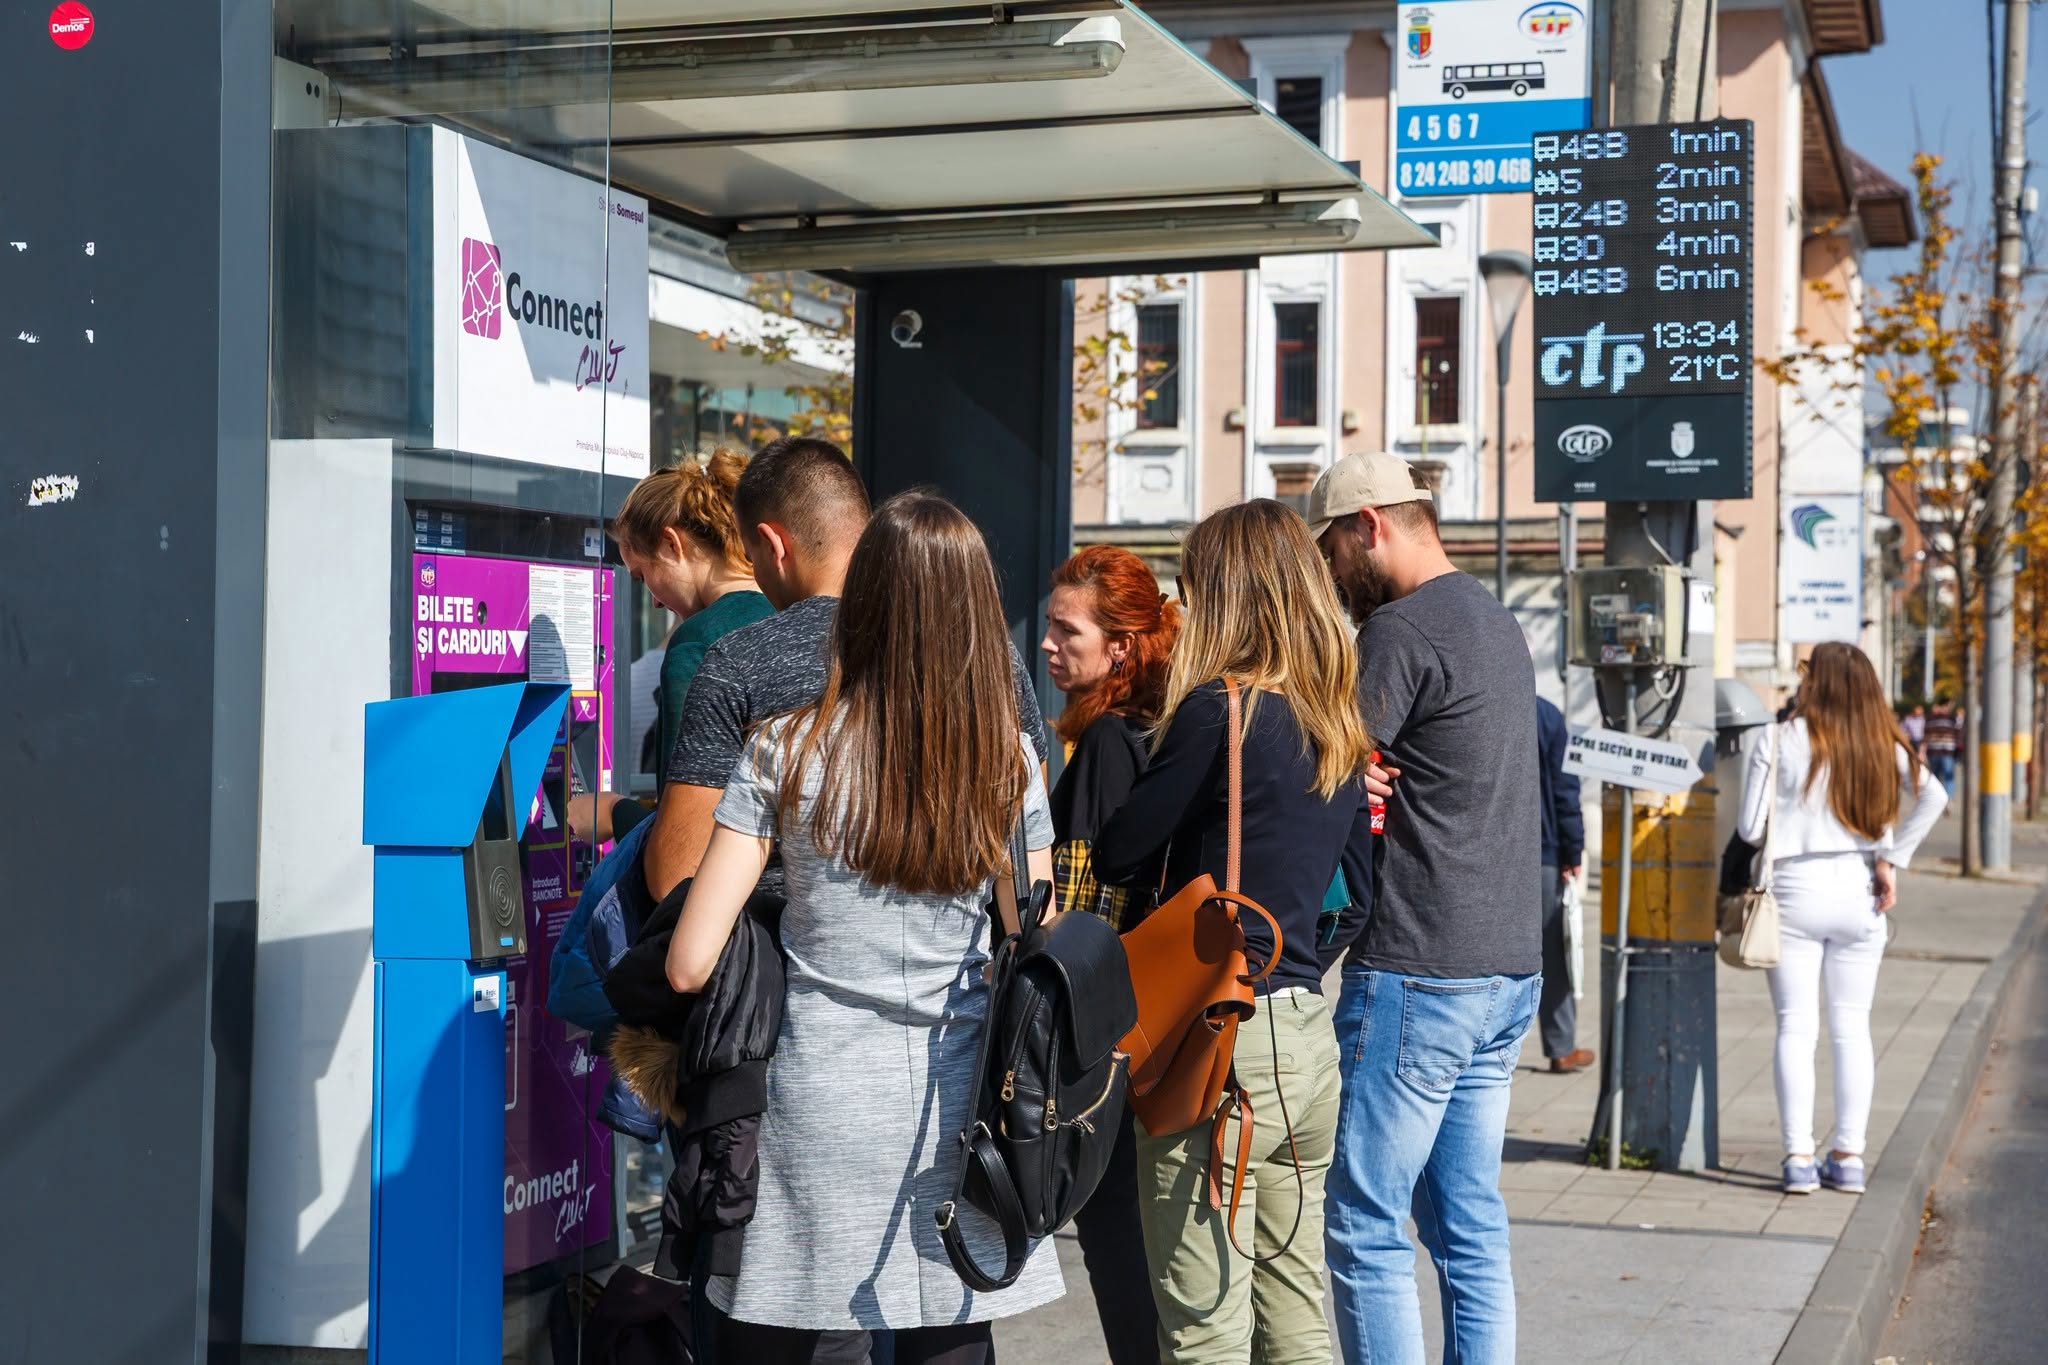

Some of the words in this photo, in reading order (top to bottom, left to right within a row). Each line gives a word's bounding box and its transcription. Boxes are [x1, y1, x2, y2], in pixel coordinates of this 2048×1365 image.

[52, 23, 85, 33] Demos
[1407, 115, 1421, 141] 4
[1427, 114, 1441, 141] 5
[1447, 113, 1462, 140] 6
[1467, 112, 1479, 139] 7
[1670, 126, 1740, 153] 1min
[1400, 162, 1412, 188] 8
[1414, 161, 1436, 187] 24
[1438, 160, 1470, 187] 24B
[1472, 159, 1496, 186] 30
[1498, 157, 1532, 184] 46B
[1560, 168, 1583, 194] 5
[1656, 160, 1740, 189] 2min
[1560, 199, 1628, 228] 24B
[1656, 195, 1740, 223] 3min
[1560, 235, 1605, 262] 30
[1656, 229, 1740, 257] 4min
[1656, 263, 1740, 290] 6min
[506, 272, 603, 341] Connect
[1653, 320, 1739, 348] 13:34
[1670, 354, 1739, 381] 21°C
[417, 595, 474, 624] BILETE
[417, 627, 433, 661] ȘI
[437, 627, 507, 655] CARDURI
[1635, 749, 1648, 761] DE
[1650, 753, 1688, 769] VOTARE
[532, 888, 562, 901] BANCNOTE
[503, 1159, 578, 1215] Connect
